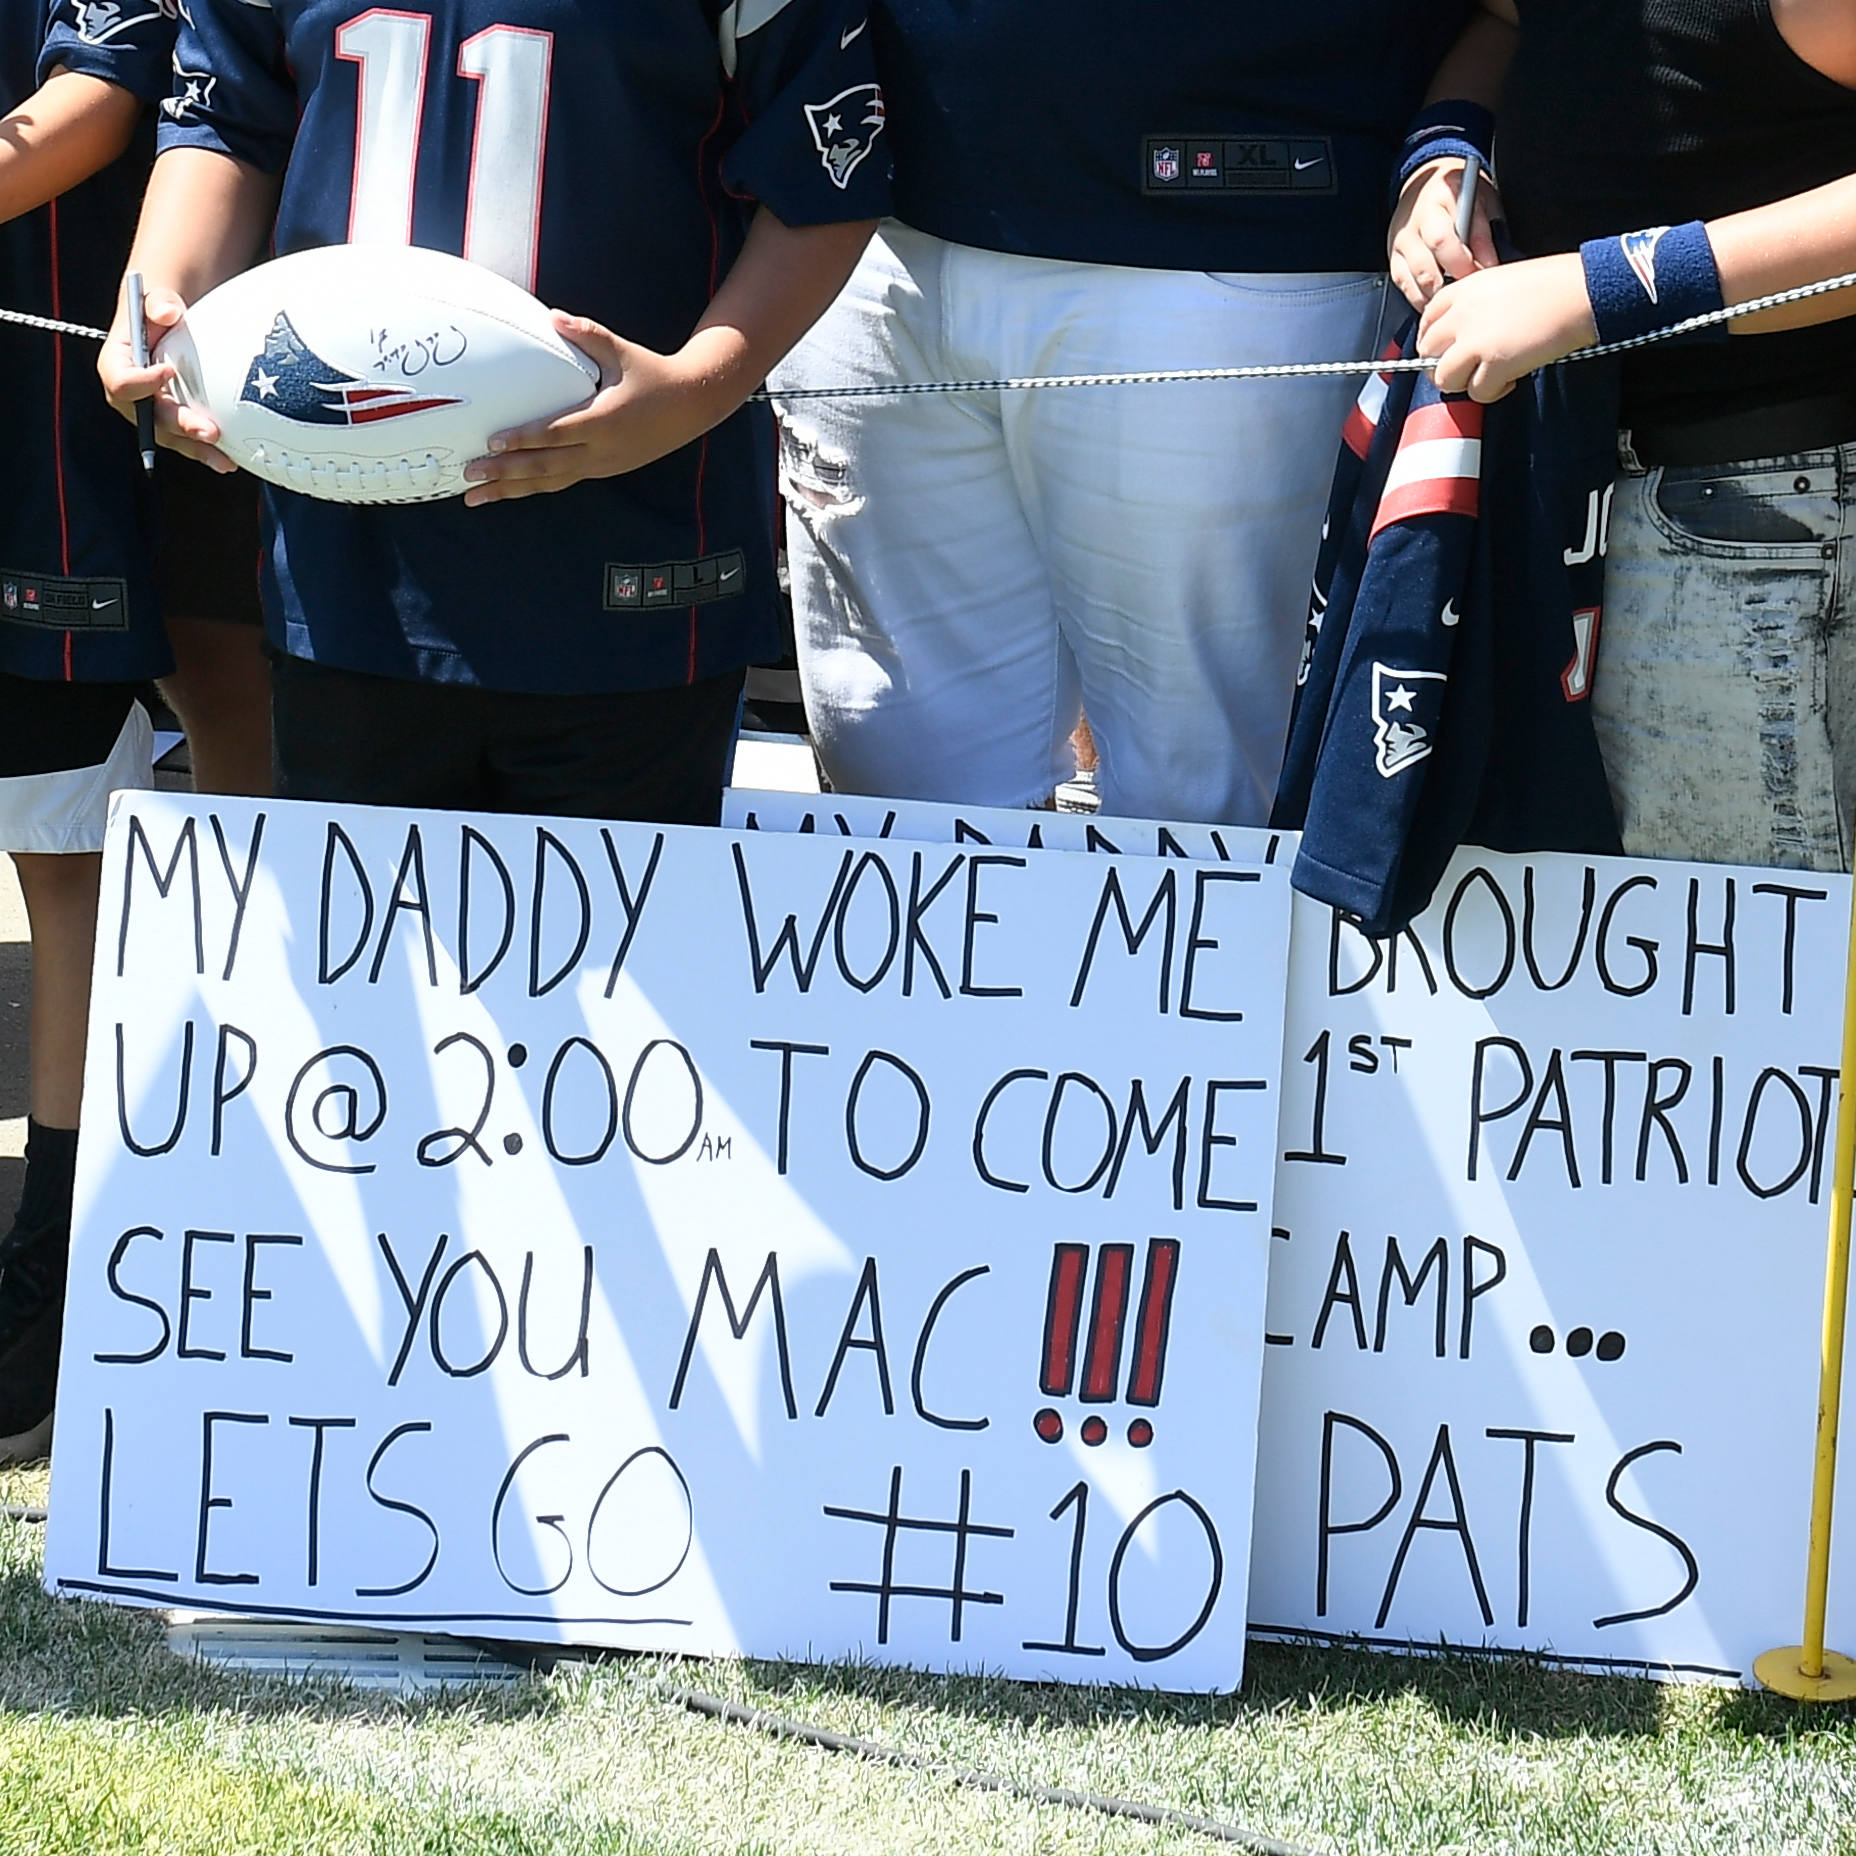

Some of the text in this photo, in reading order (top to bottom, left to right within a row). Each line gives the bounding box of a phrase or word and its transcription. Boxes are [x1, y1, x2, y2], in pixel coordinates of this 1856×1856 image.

[333, 7, 555, 296] 11
[1239, 144, 1276, 168] XL
[116, 811, 1262, 1022] MY DADDY WOKE ME
[113, 1020, 259, 1158] UP
[749, 1037, 929, 1182] TO
[972, 1066, 1267, 1214] COME
[92, 1226, 304, 1365] SEE
[376, 1232, 594, 1388] YOU
[669, 1246, 991, 1433] MAC
[97, 1408, 1226, 1664] LETS GO #10
[1313, 1408, 1700, 1632] PATS
